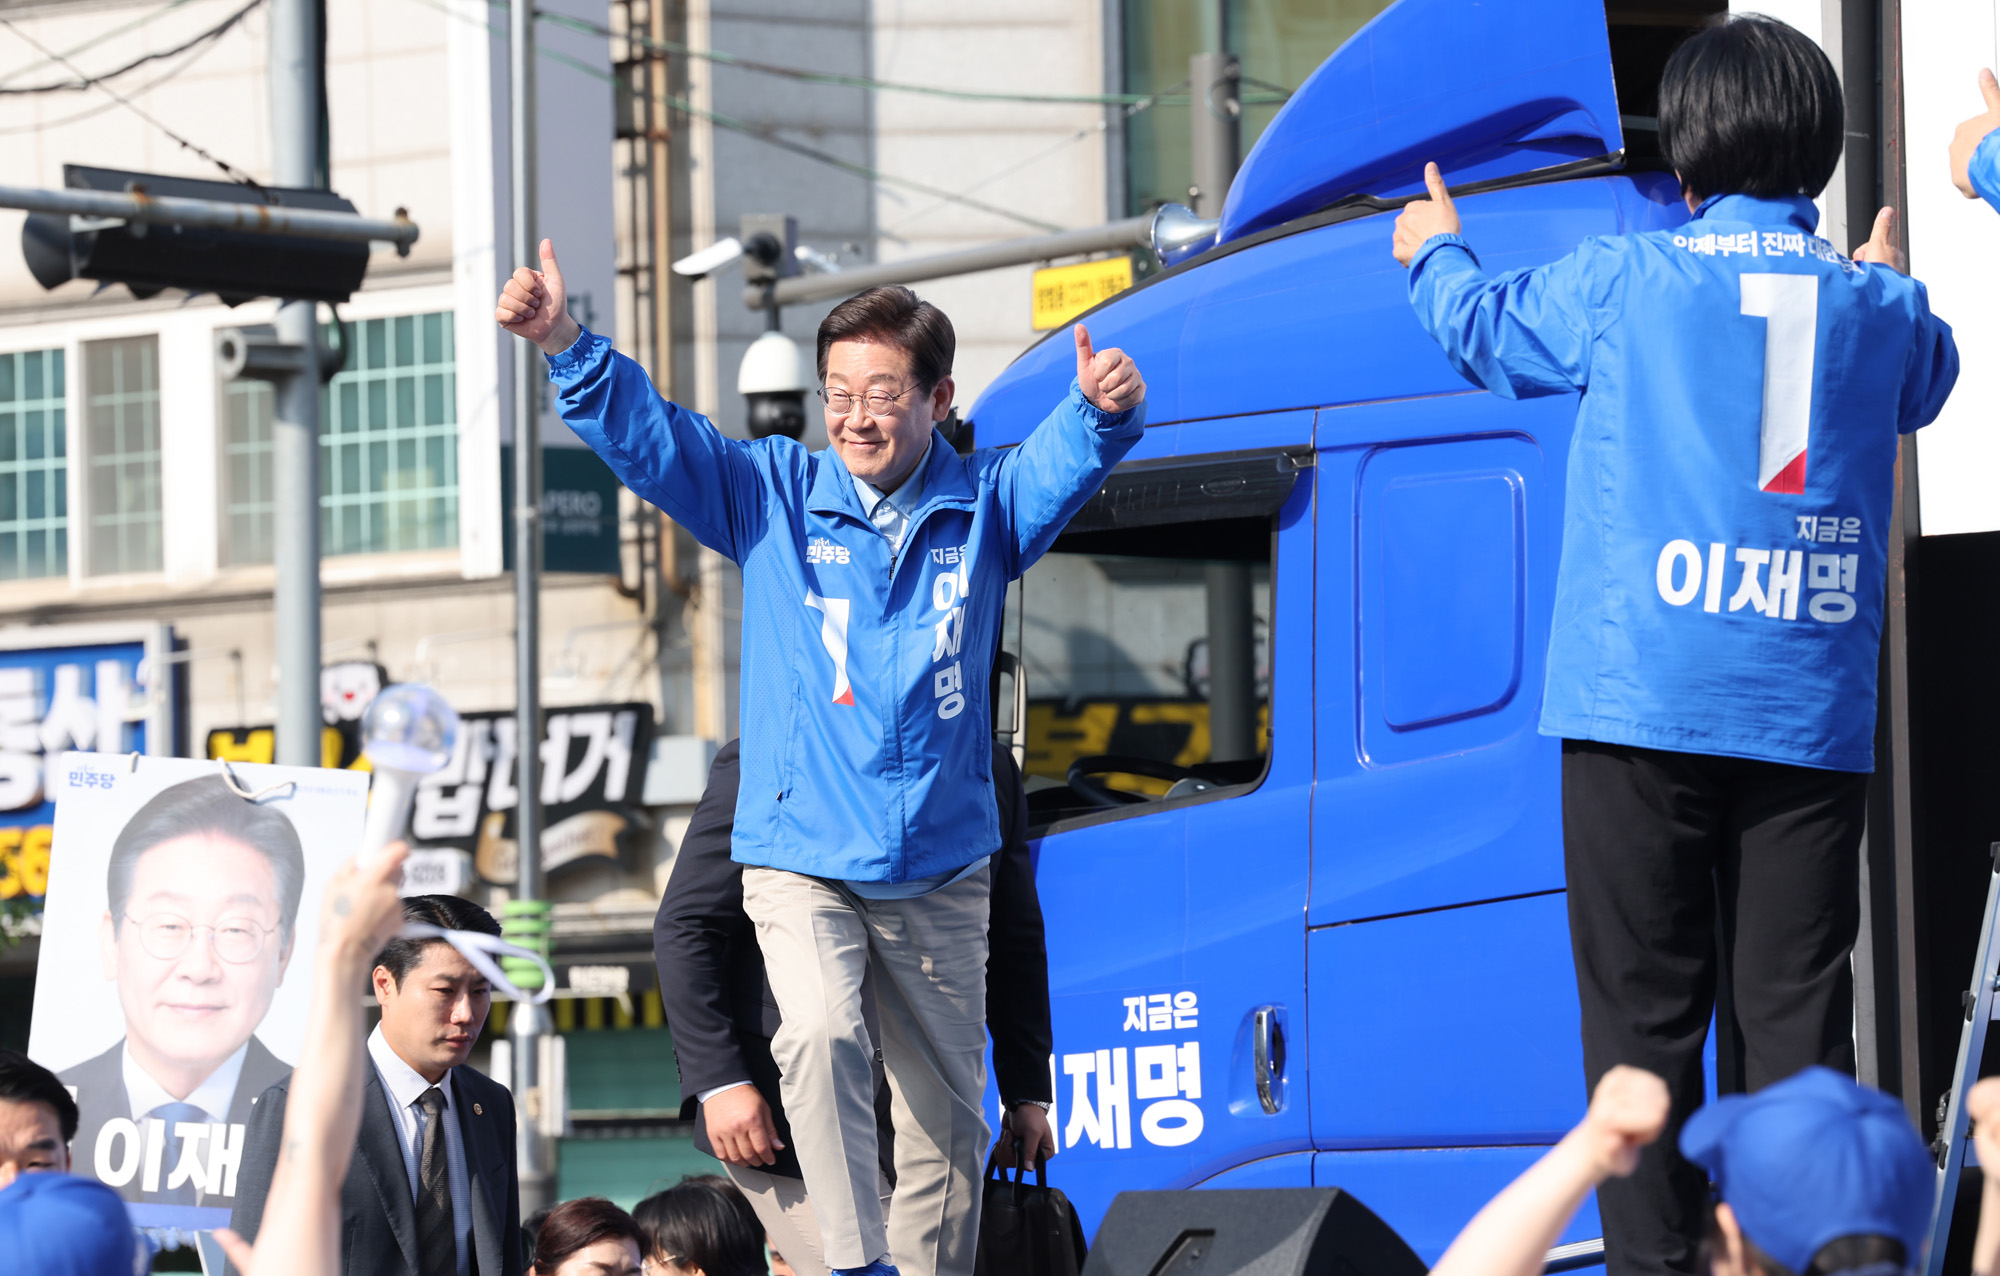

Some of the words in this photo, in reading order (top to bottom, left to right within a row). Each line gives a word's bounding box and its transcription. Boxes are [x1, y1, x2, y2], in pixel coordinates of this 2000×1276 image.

[1673, 231, 1758, 257] 이제부터
[1762, 232, 1806, 257] 진짜
[1740, 273, 1818, 495] 1
[806, 545, 851, 565] 민주당
[1796, 515, 1861, 543] 지금은
[1656, 539, 1859, 624] 이재명
[804, 585, 855, 707] 1
[932, 557, 969, 720] 이재명
[68, 771, 117, 790] 민주당
[1123, 991, 1199, 1032] 지금은
[999, 1041, 1204, 1154] 재명
